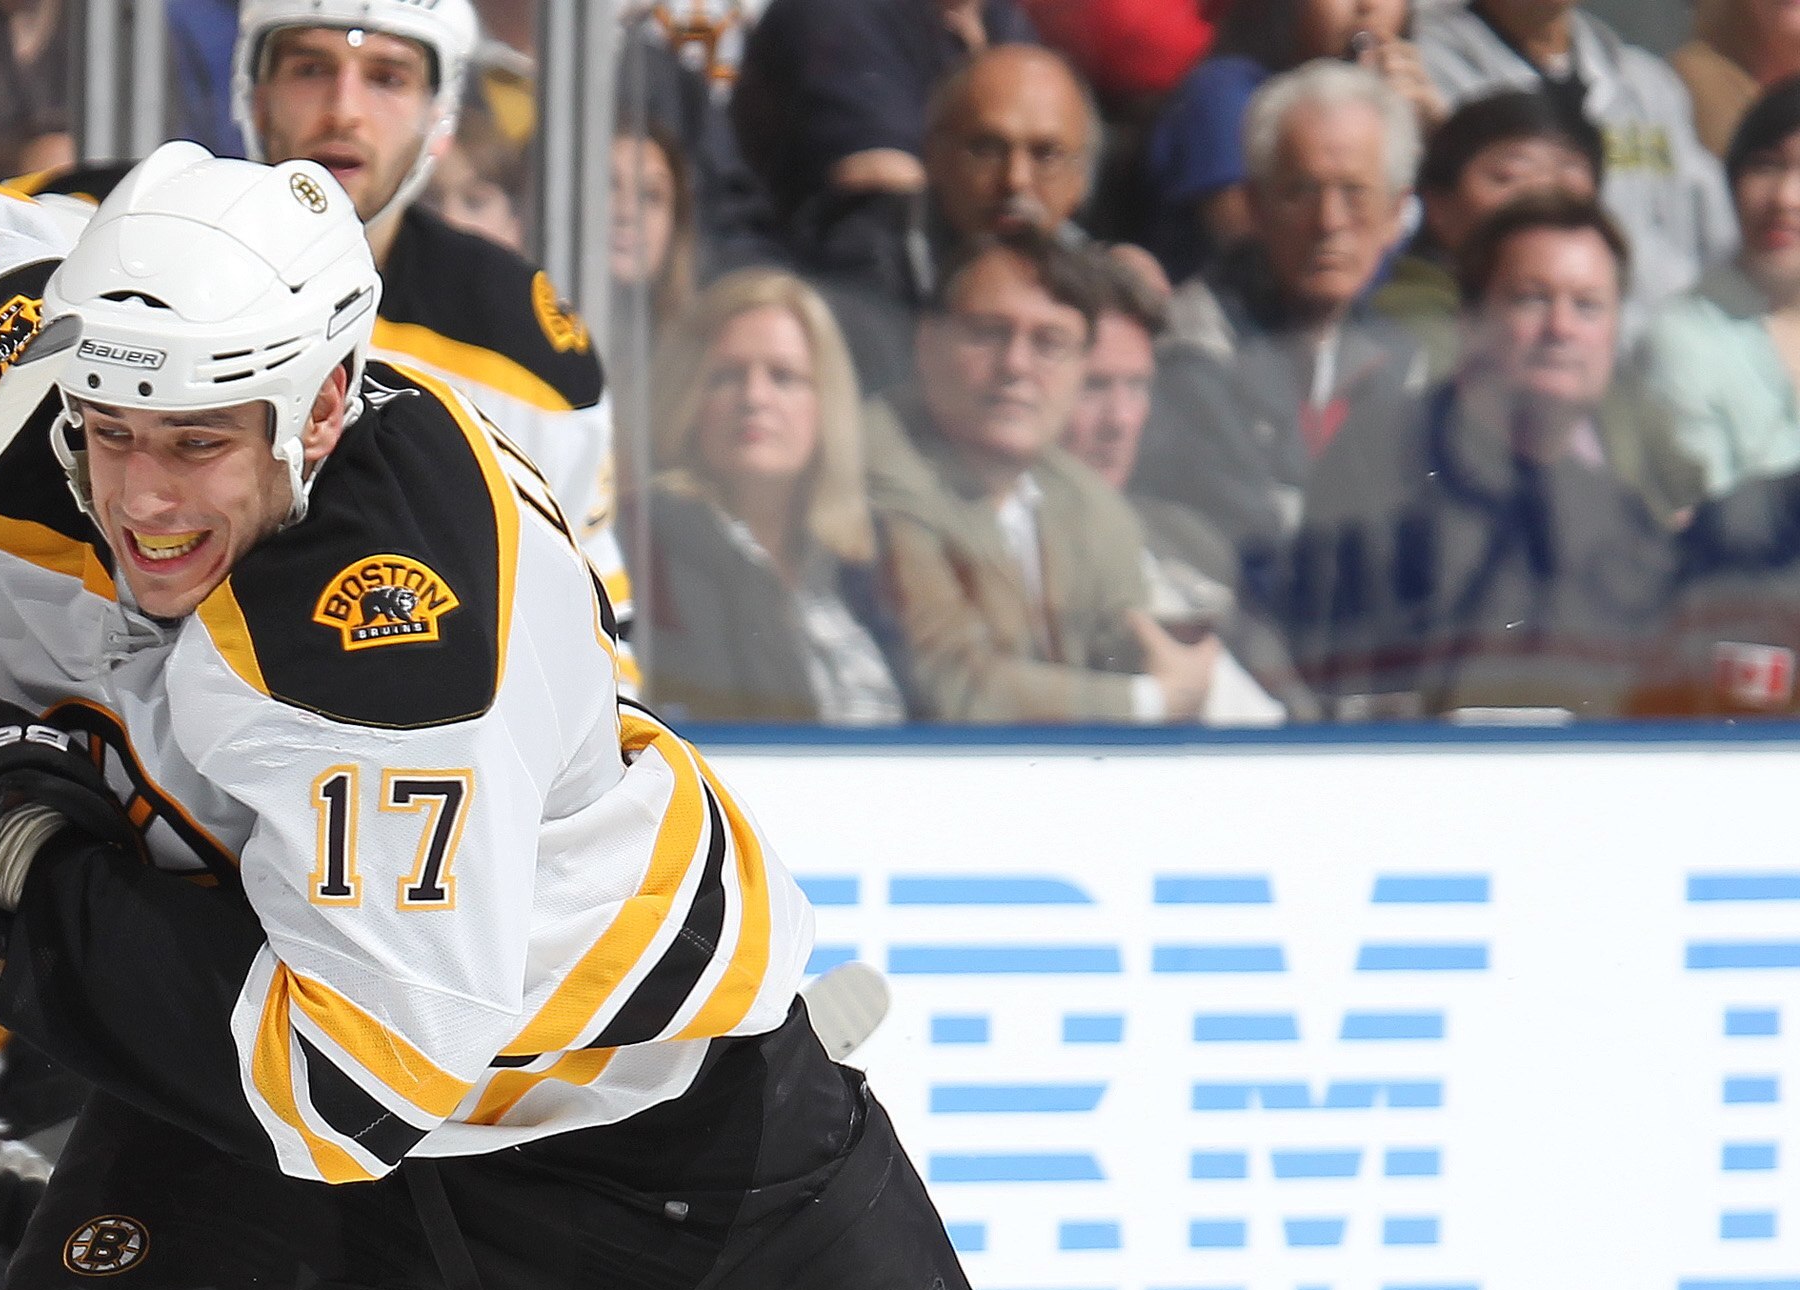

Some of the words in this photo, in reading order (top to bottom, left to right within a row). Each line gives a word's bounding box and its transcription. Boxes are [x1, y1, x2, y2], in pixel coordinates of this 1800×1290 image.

[80, 341, 158, 366] BAUER
[323, 562, 448, 622] BOSTON
[357, 622, 423, 640] BRUINS
[308, 762, 477, 912] 17
